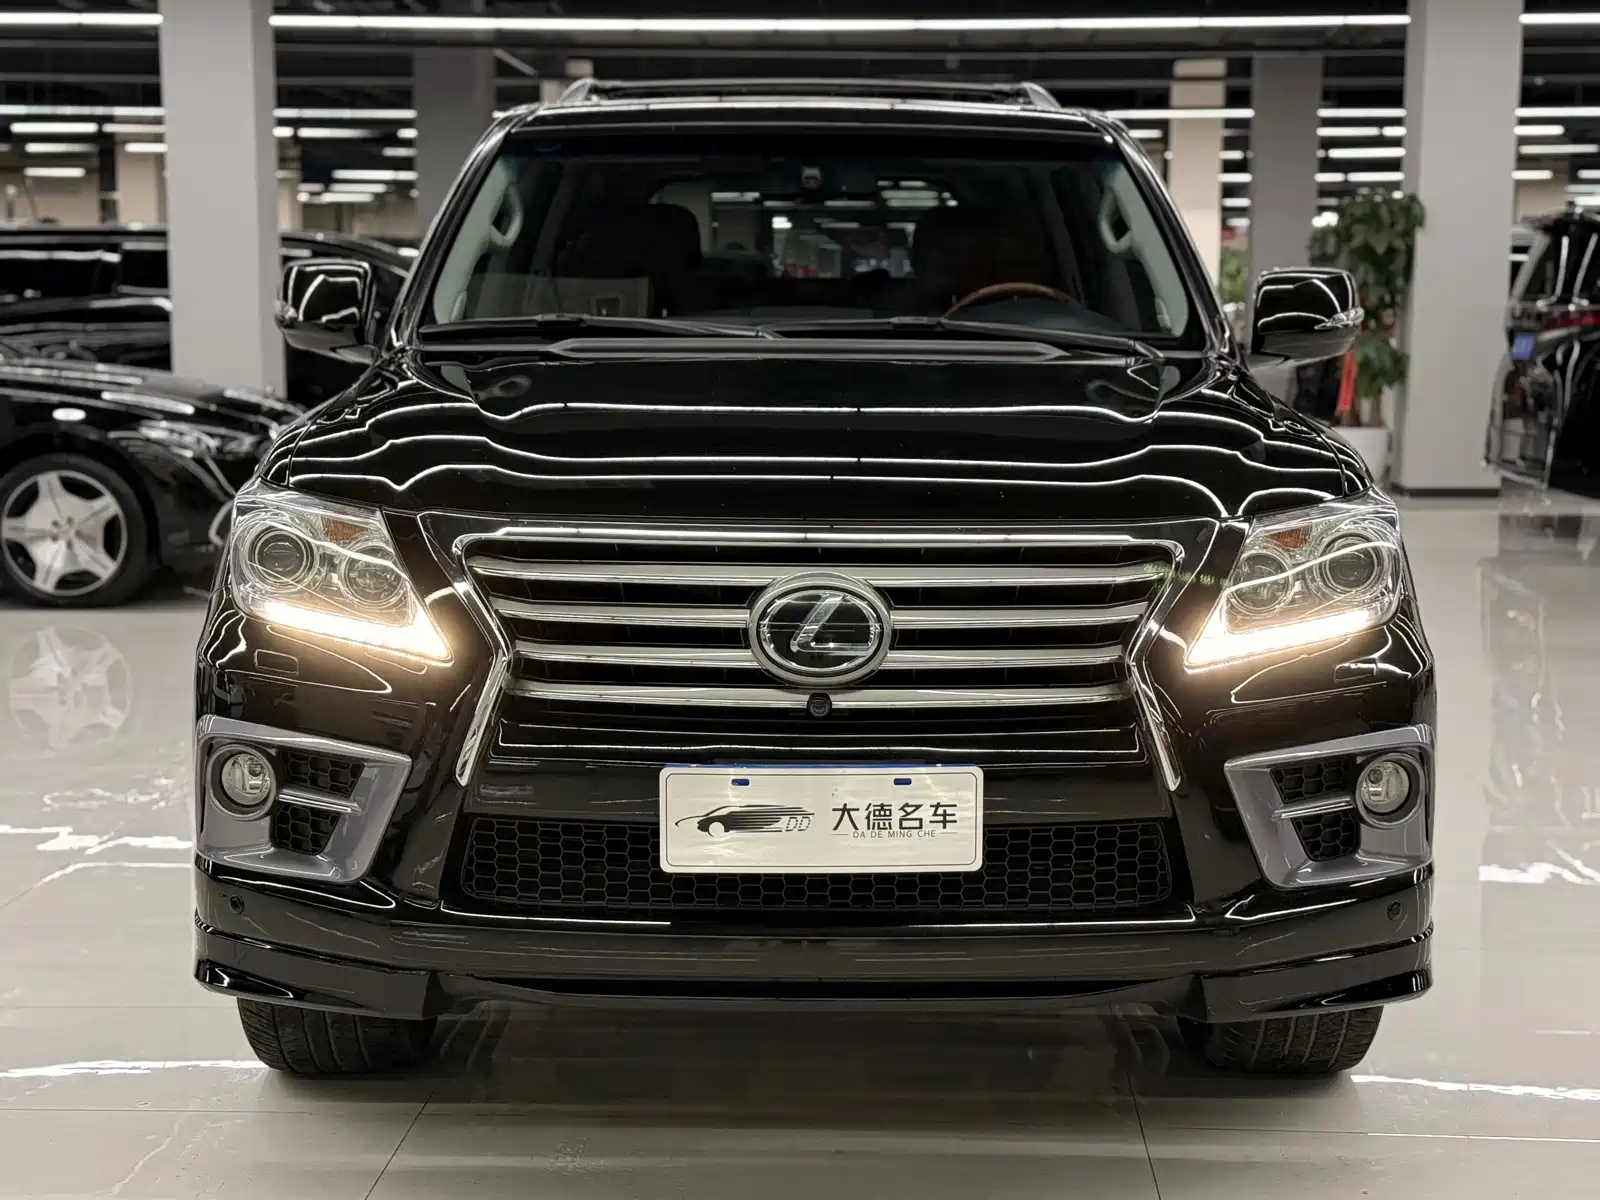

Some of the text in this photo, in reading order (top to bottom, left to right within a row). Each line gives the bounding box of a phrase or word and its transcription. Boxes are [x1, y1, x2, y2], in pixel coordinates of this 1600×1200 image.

[832, 802, 957, 830] 大德名车
[852, 829, 936, 839] DA DE MING CHE
